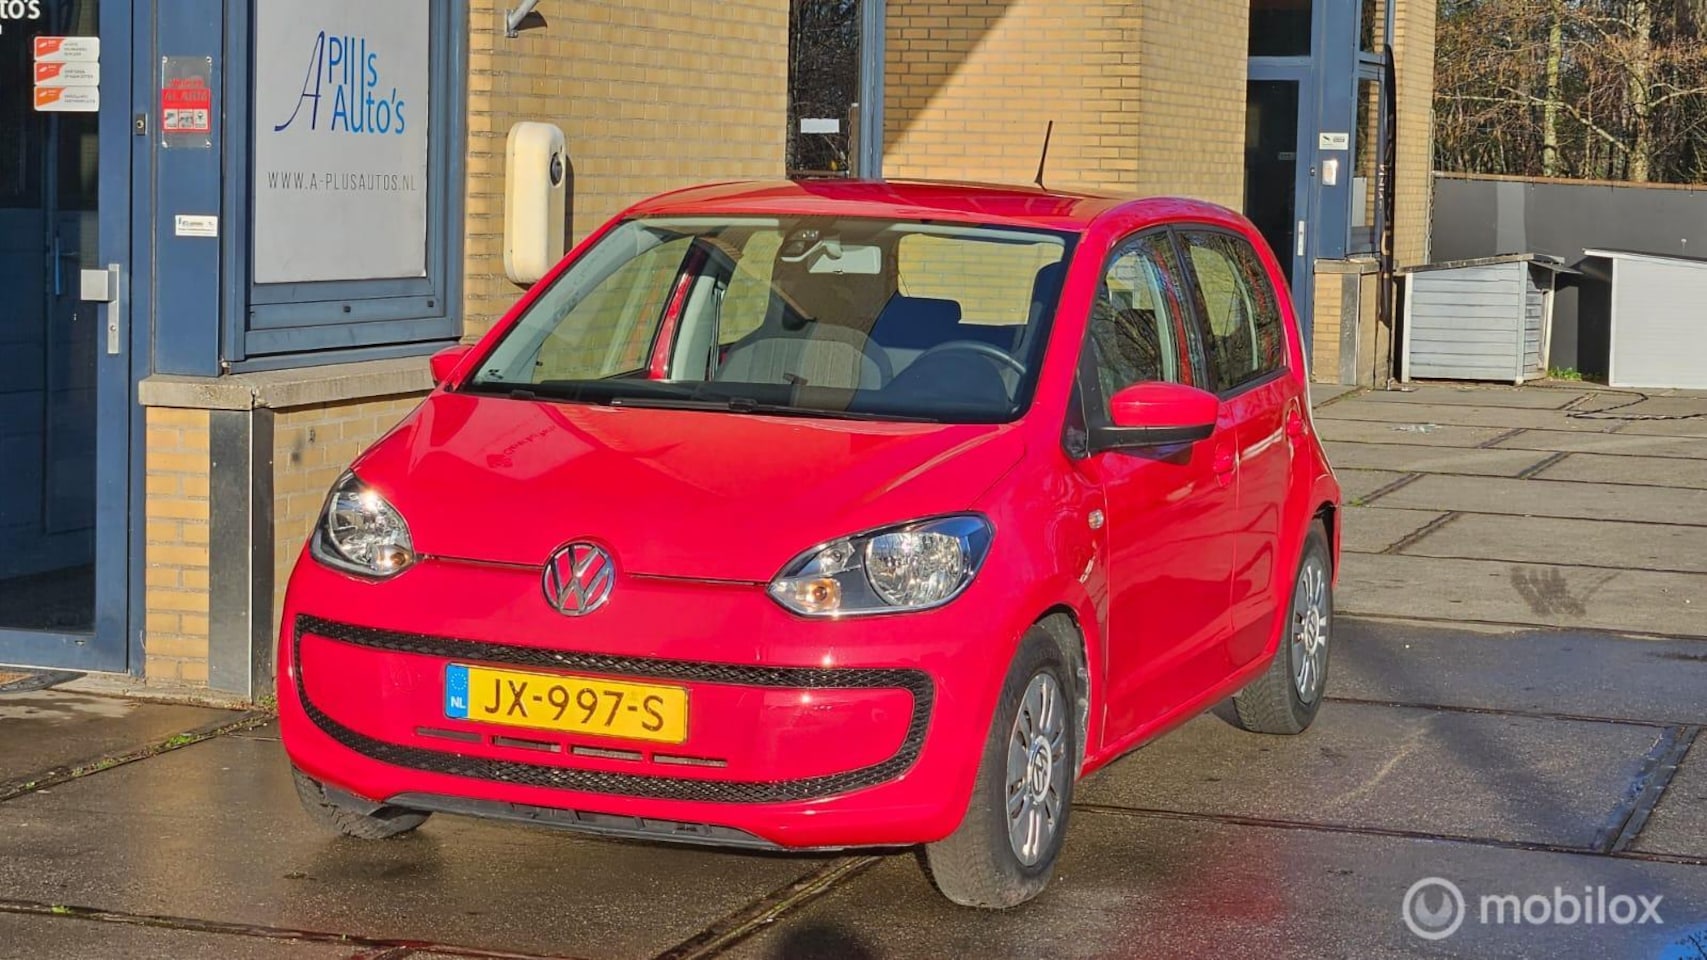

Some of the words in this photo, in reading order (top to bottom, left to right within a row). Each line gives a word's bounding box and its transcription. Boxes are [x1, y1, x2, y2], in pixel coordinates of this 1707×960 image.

[268, 172, 417, 192] WWW.A-PLUSAUTOS.NL
[450, 696, 467, 709] NL
[484, 678, 665, 732] JX-997-S
